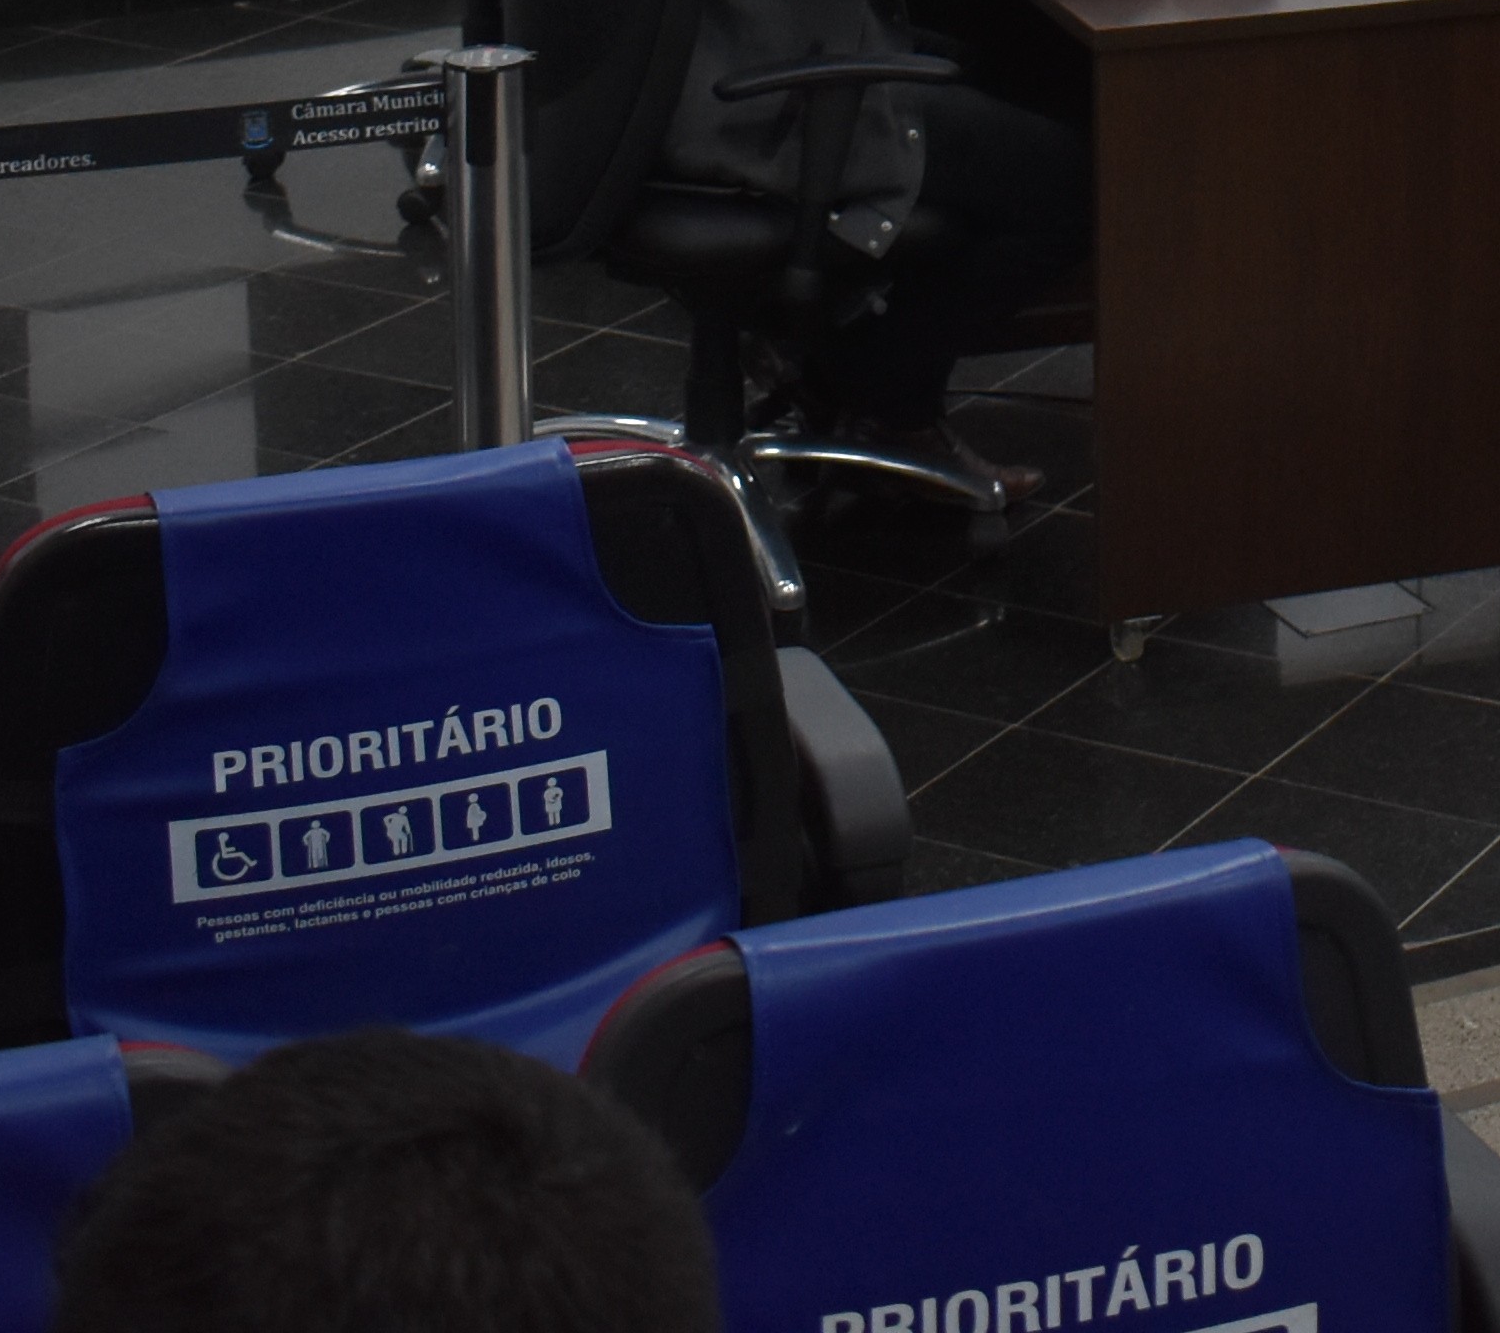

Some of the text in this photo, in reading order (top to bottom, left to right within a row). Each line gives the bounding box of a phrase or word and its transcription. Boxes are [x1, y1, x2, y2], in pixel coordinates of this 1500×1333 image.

[290, 100, 368, 121] Câmara
[292, 116, 440, 147] Acesso restrito
[212, 696, 564, 795] PRIORITÁRIO
[196, 851, 596, 929] Pessoas com deficiência ou mobilidade reduzida, idosos,
[214, 866, 582, 944] gestantes, lactantes e pessoas com crianças de colo
